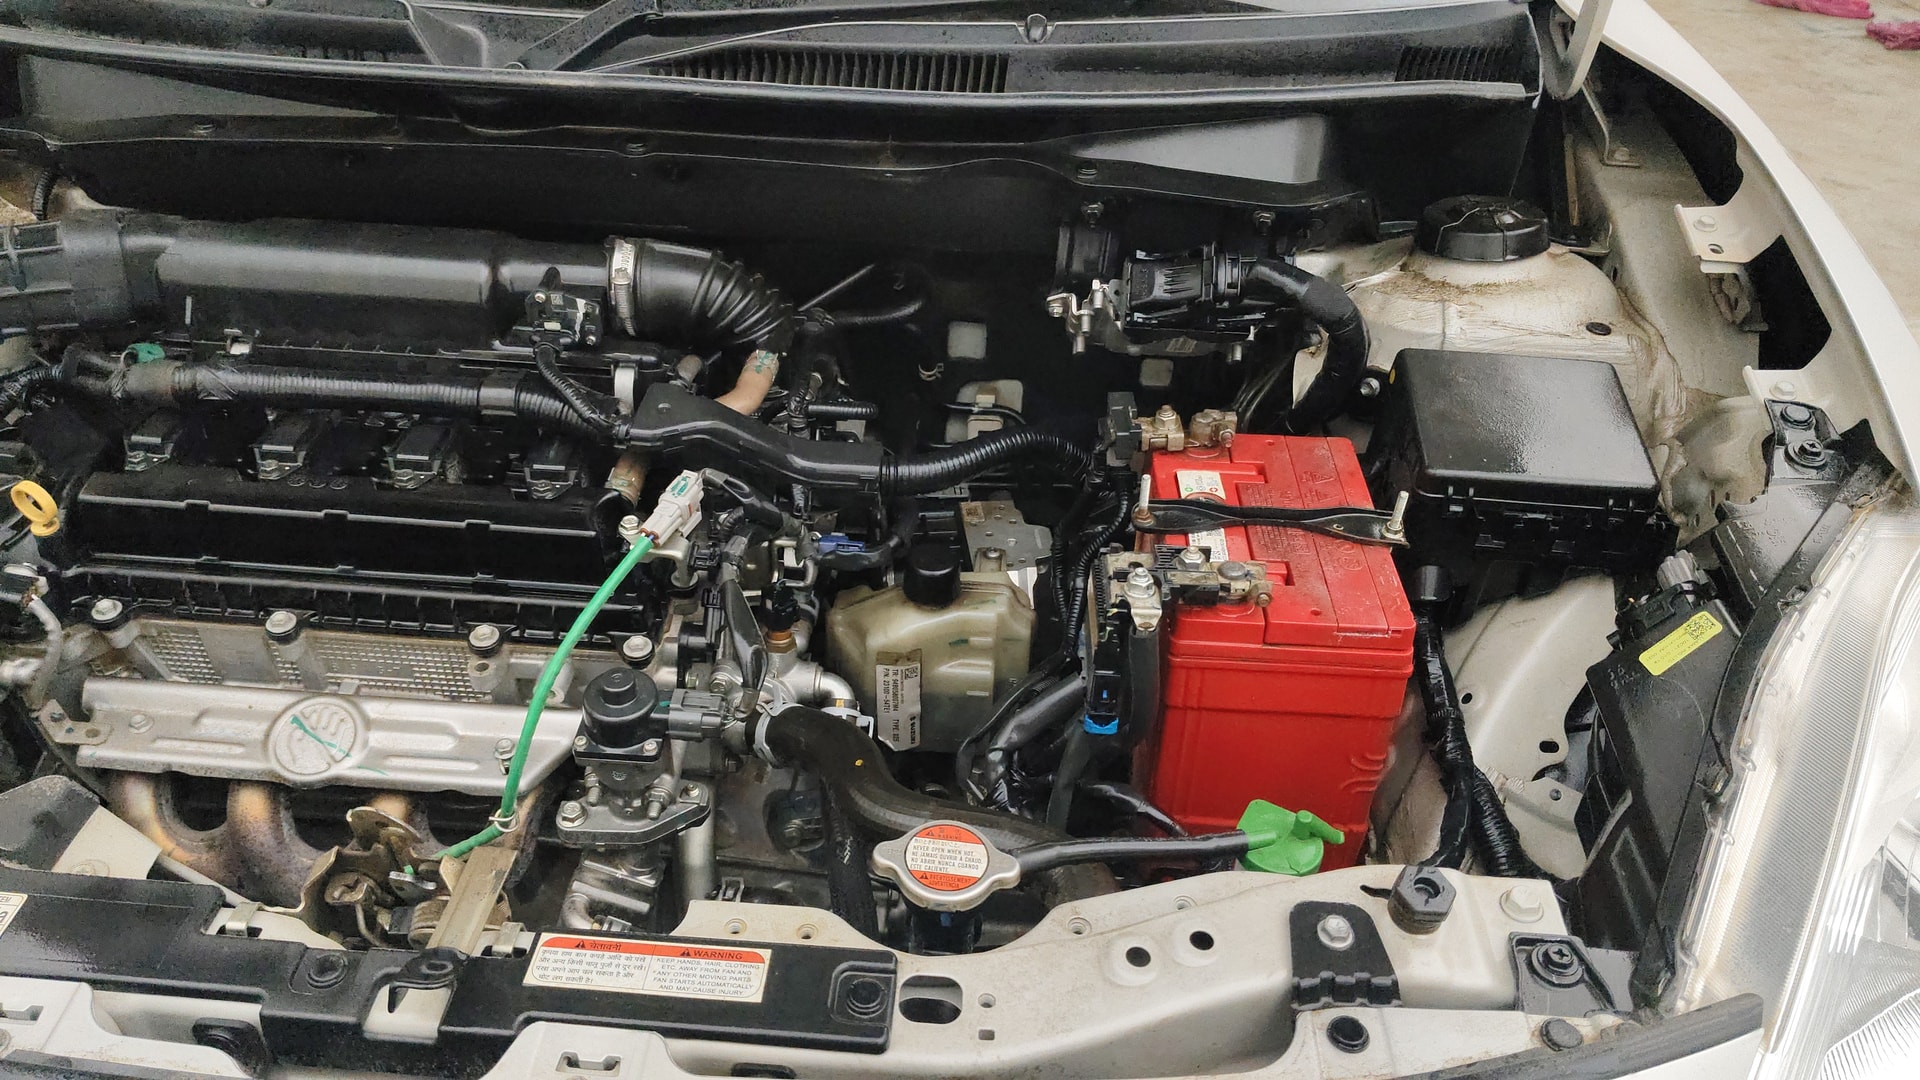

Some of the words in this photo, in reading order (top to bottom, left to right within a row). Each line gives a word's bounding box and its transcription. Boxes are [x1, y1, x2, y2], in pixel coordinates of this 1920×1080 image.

[589, 940, 622, 951] चेतावनी
[693, 949, 743, 960] WARNING
[725, 962, 760, 970] CLOTHING
[673, 971, 697, 979] OTHER
[699, 973, 727, 981] MOVING
[668, 978, 695, 986] STARTS
[697, 980, 753, 989] AUTOMATICALLY
